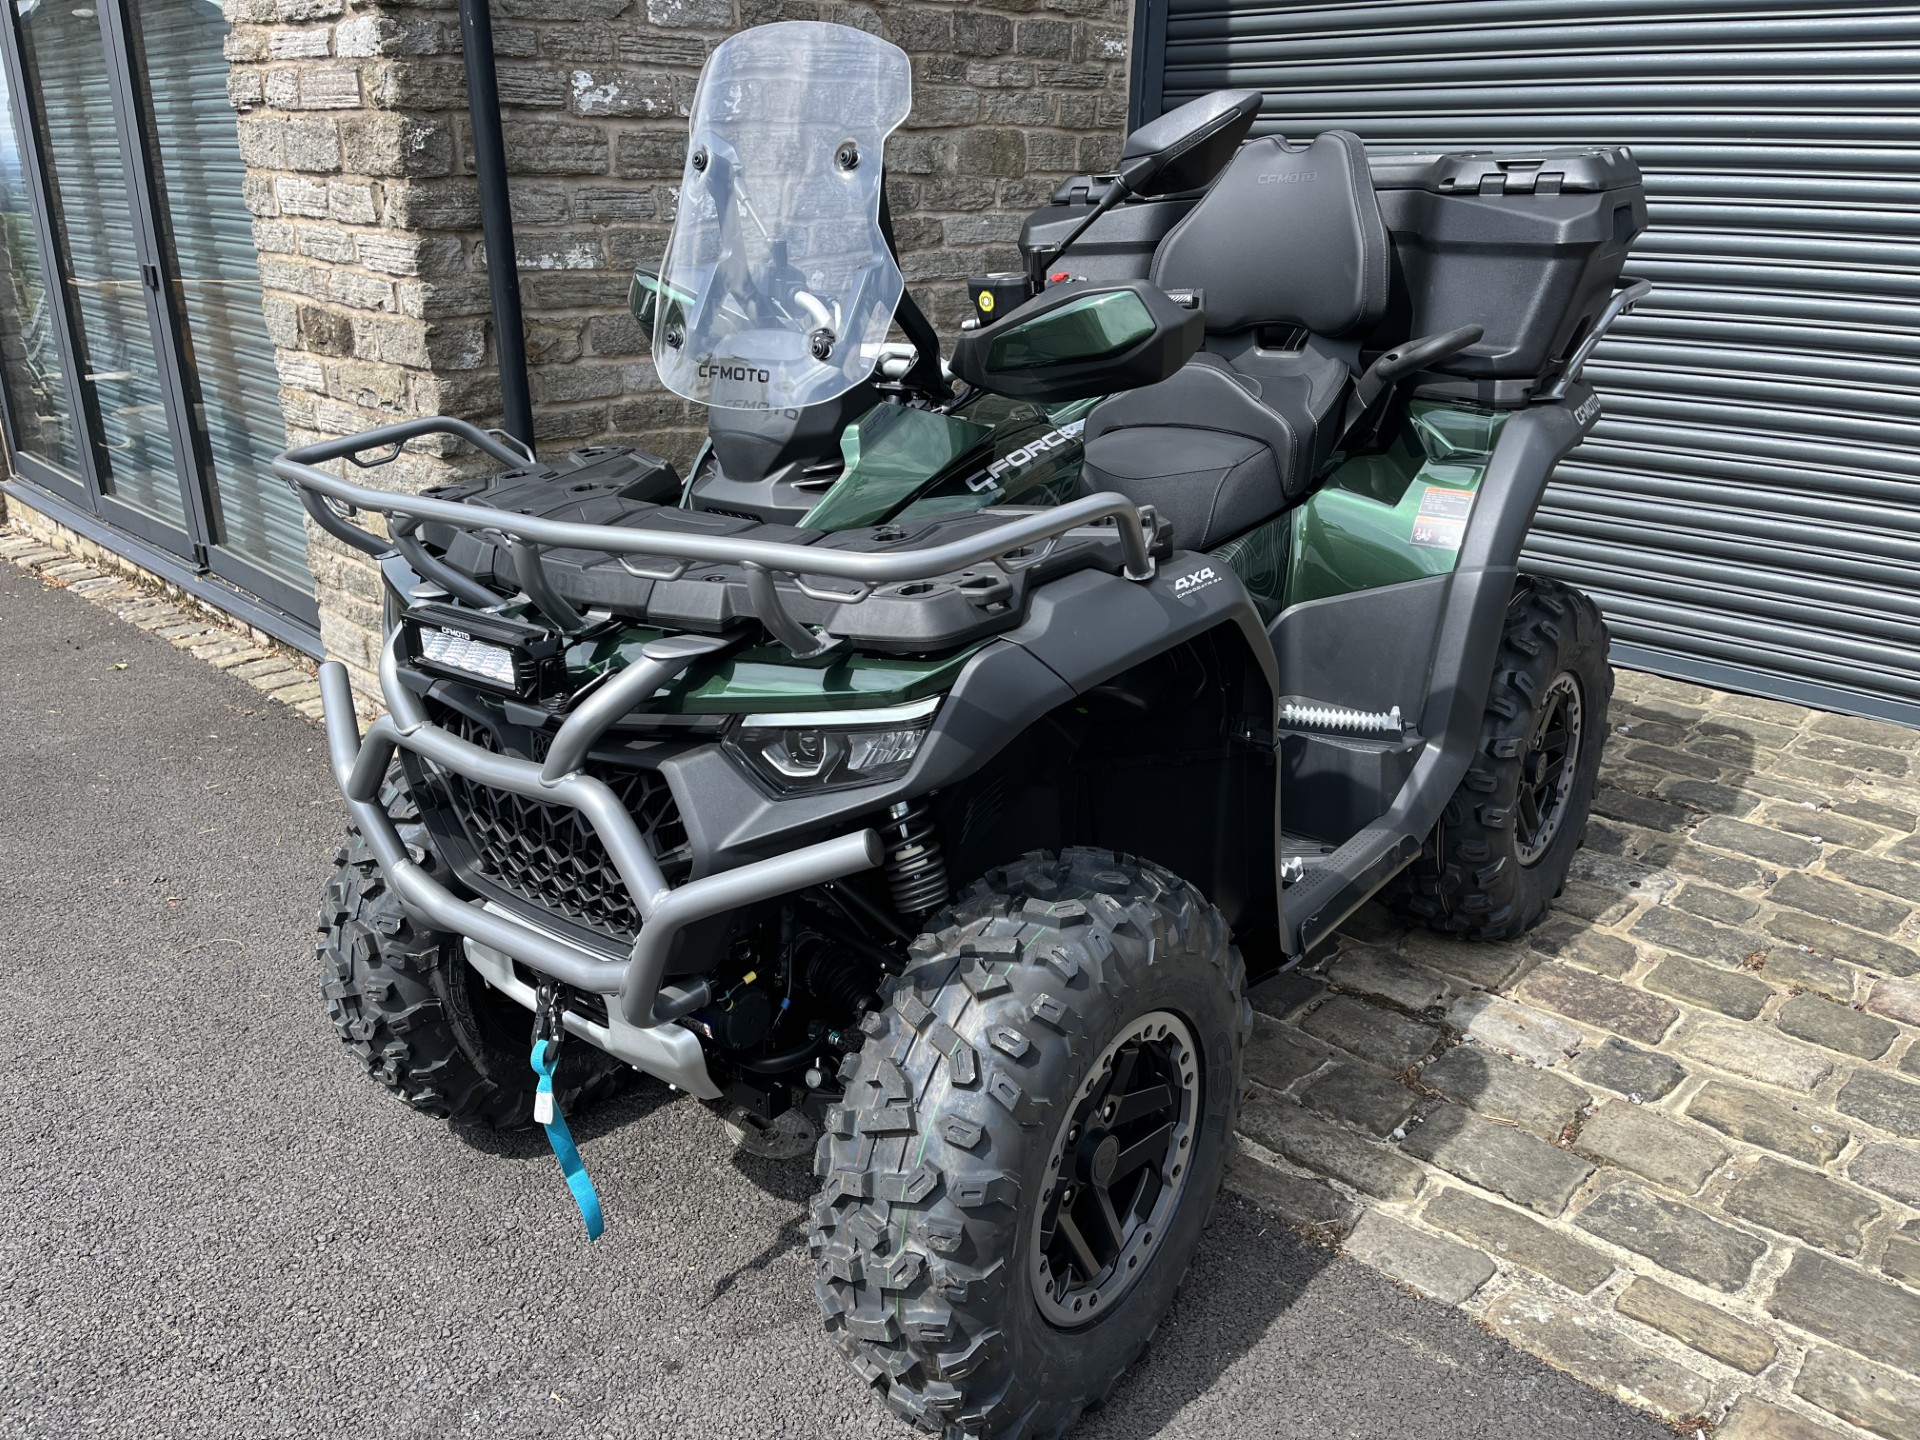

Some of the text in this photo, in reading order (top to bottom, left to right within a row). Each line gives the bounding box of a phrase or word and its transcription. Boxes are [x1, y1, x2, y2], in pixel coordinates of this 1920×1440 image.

[1257, 170, 1319, 185] CFMOTO
[698, 365, 770, 384] CFMOTO
[1573, 393, 1601, 426] CFMOTO
[441, 626, 470, 641] CFMOTO
[1208, 1030, 1233, 1144] CST
